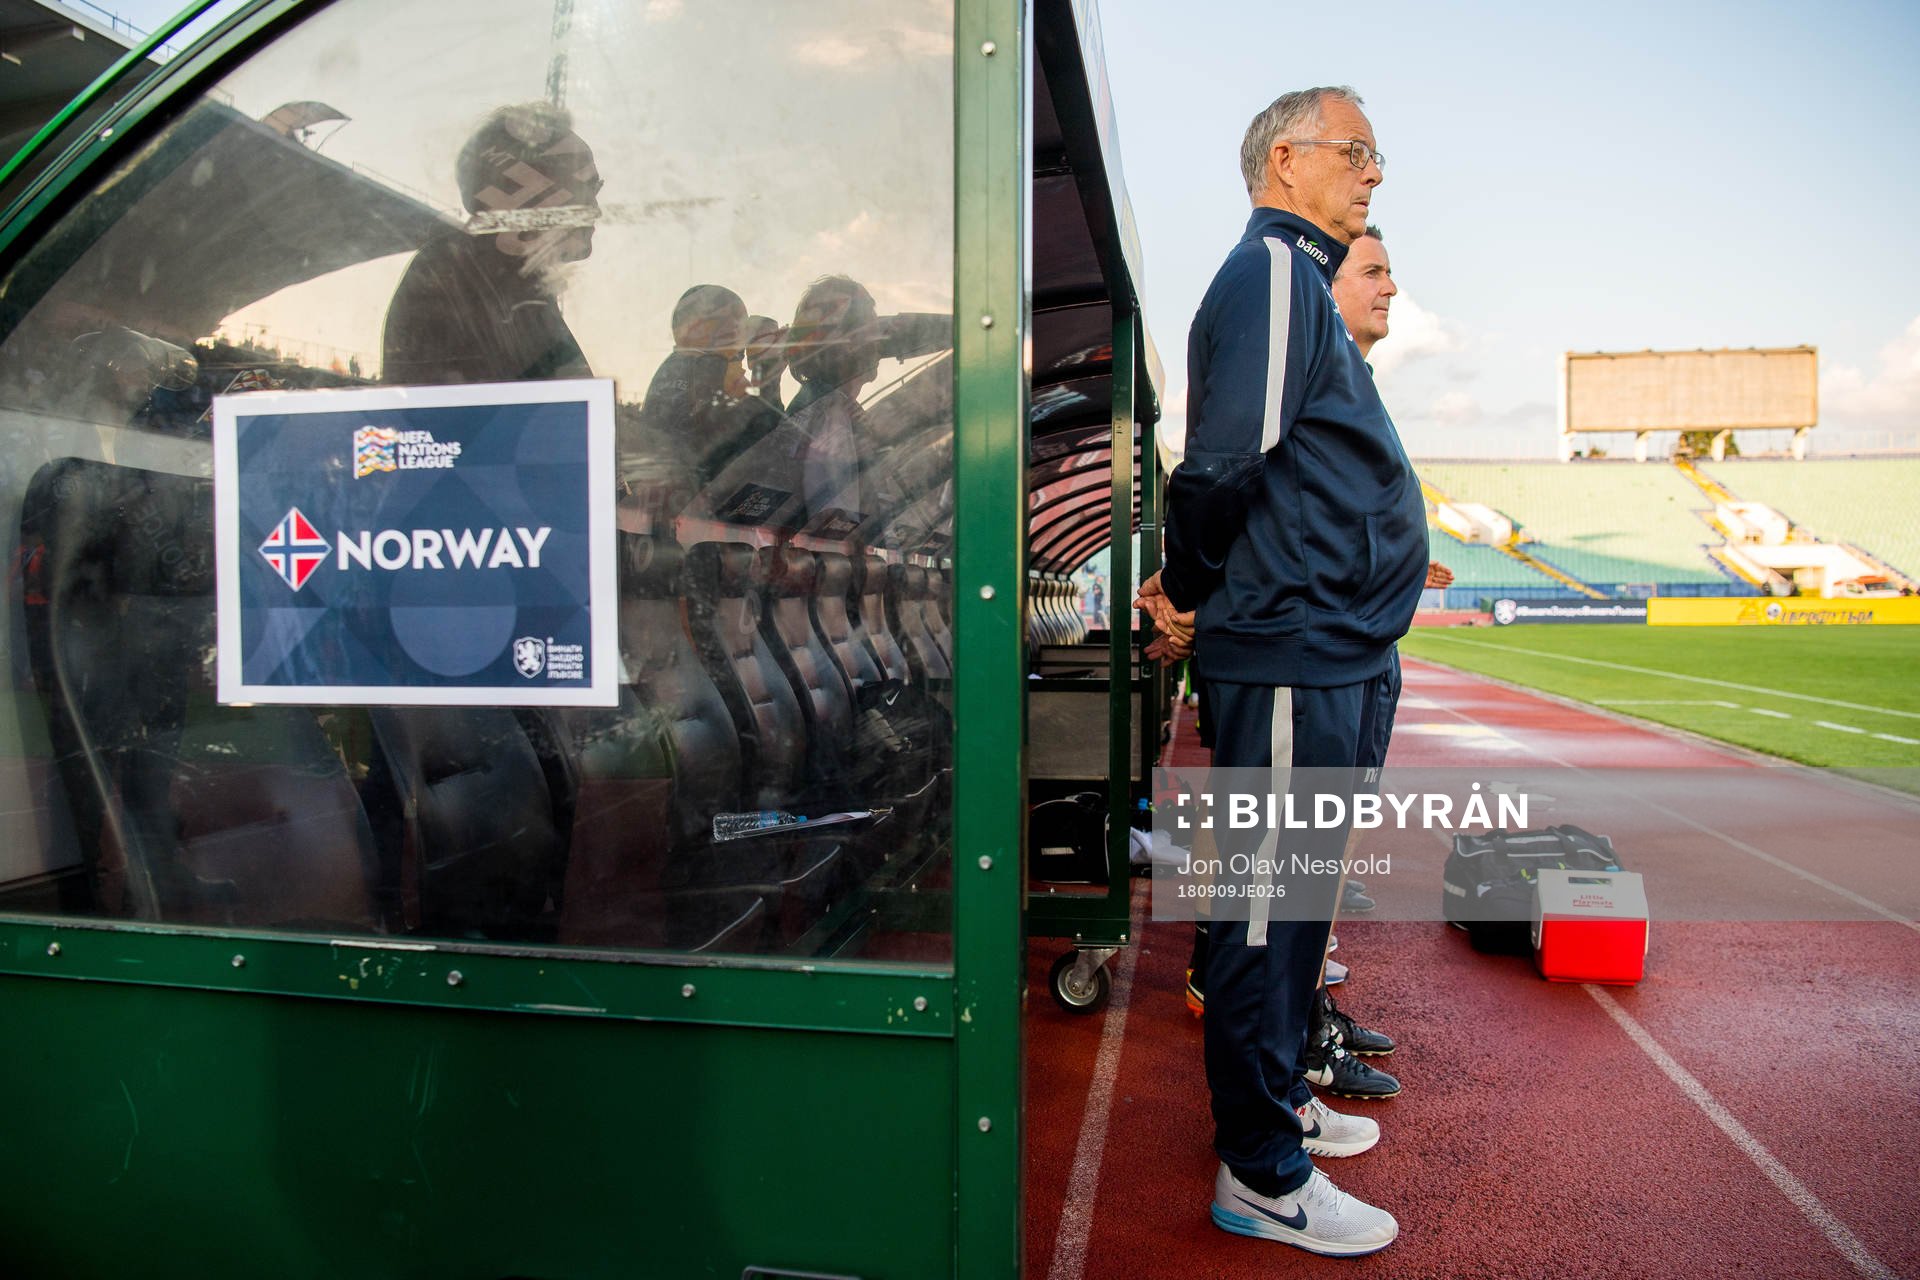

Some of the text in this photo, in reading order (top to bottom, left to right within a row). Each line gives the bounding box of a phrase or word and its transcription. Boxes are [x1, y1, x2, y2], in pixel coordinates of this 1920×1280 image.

[1296, 235, 1329, 265] bama
[398, 430, 435, 444] UEFA
[398, 441, 462, 457] NATIONS
[398, 455, 455, 470] LEAGUE
[337, 526, 552, 571] NORWAY
